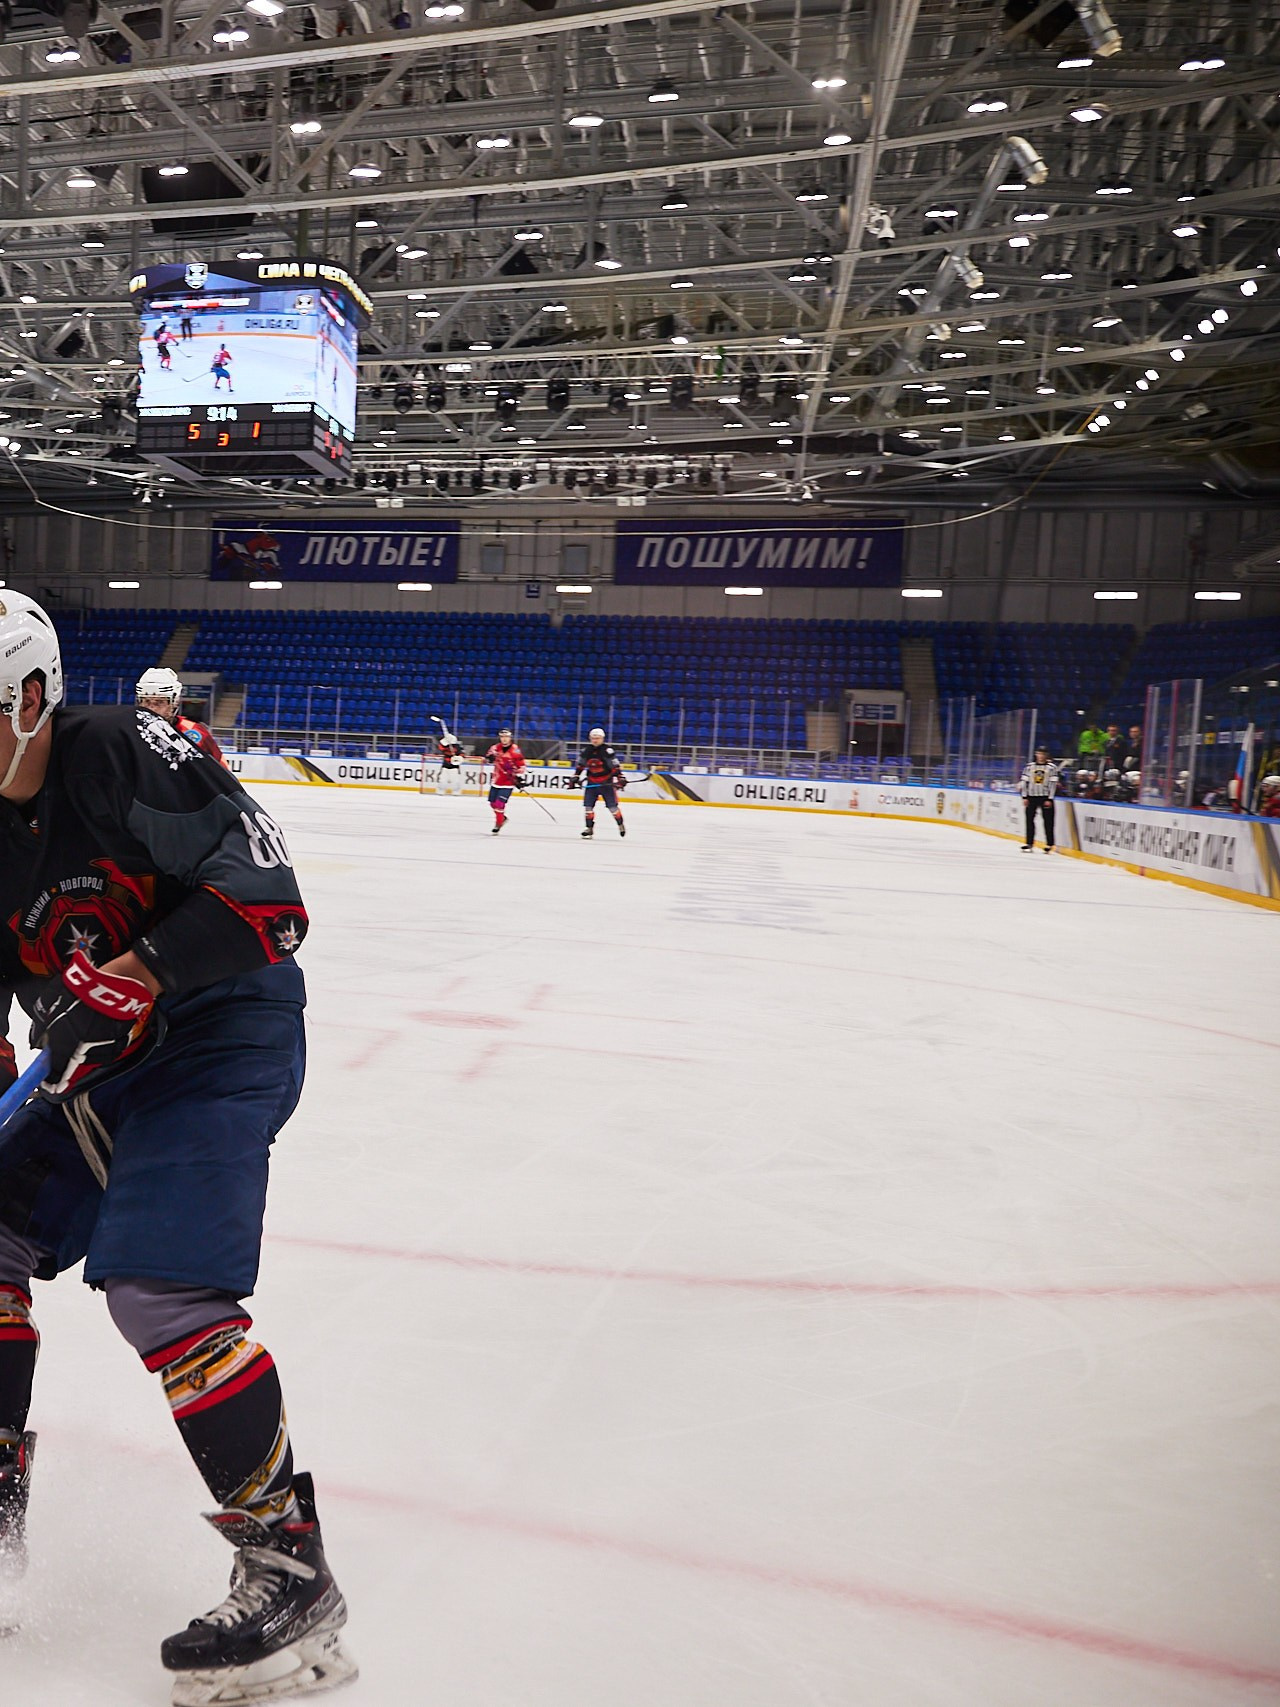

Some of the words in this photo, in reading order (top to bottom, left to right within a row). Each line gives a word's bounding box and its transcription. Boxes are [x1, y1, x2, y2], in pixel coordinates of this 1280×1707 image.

[187, 423, 201, 440] 5
[217, 433, 230, 447] 3
[252, 422, 261, 438] 1
[299, 535, 448, 567] ЛЮТЫЕ!
[636, 536, 874, 570] ПОШУМИМ!
[4, 635, 33, 658] BAUER
[338, 765, 442, 784] ОФИЦЕРСК
[465, 770, 573, 791] ХОЙНАЯ
[734, 783, 827, 804] OHLIGA.RU
[239, 810, 293, 869] 88
[24, 890, 52, 929] НИЖНИЙ
[59, 876, 104, 893] НОВГОРОД
[64, 962, 150, 1016] CCM
